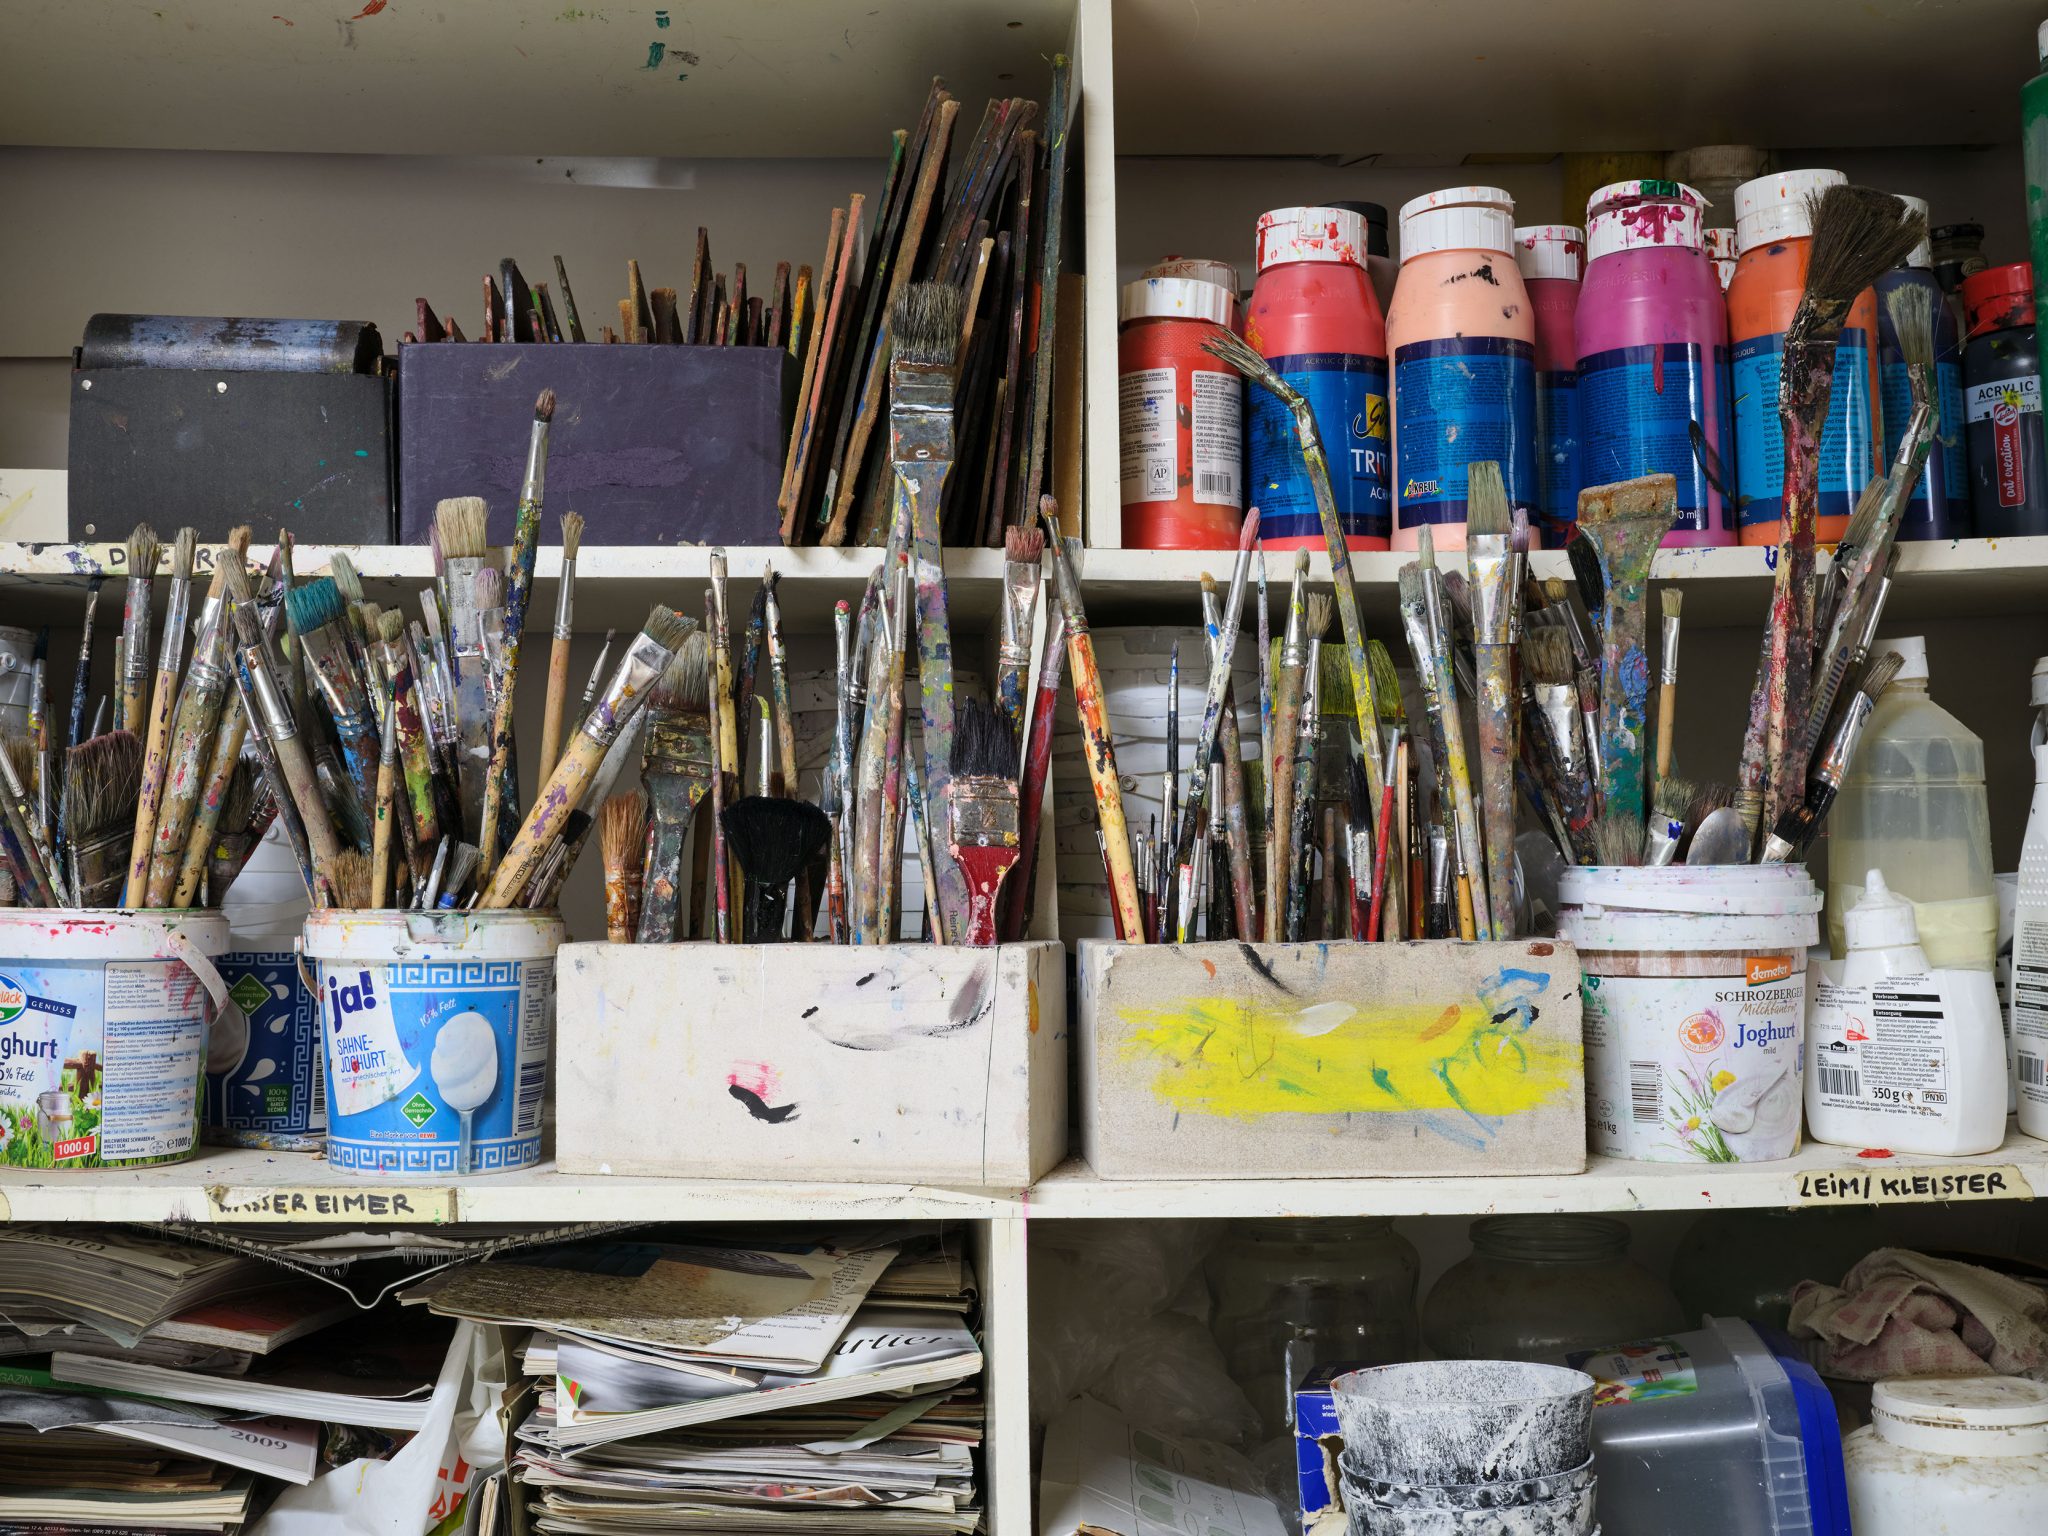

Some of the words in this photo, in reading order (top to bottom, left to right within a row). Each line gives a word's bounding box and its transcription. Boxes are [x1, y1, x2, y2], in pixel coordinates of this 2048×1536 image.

[1978, 380, 2034, 400] ACRYLIC
[2000, 434, 2014, 478] creation
[1153, 468, 1167, 479] AP
[1750, 964, 1788, 981] demeter
[328, 970, 377, 1034] ja!
[1714, 986, 1804, 1003] SCHROZBERGER
[31, 1000, 71, 1015] GENUSS
[439, 998, 457, 1013] Fett
[1733, 1020, 1796, 1049] Joghurt
[336, 1034, 374, 1056] SAHNE-
[1763, 1047, 1777, 1055] mild
[340, 1050, 386, 1074] JOGHURT
[16, 1067, 35, 1082] Fett
[1925, 1093, 1945, 1102] PN10
[58, 1142, 82, 1156] 1000
[83, 1141, 90, 1154] g
[1880, 1172, 2008, 1196] KLEISTER
[315, 1192, 415, 1216] EIMER
[230, 1430, 288, 1450] 2009
